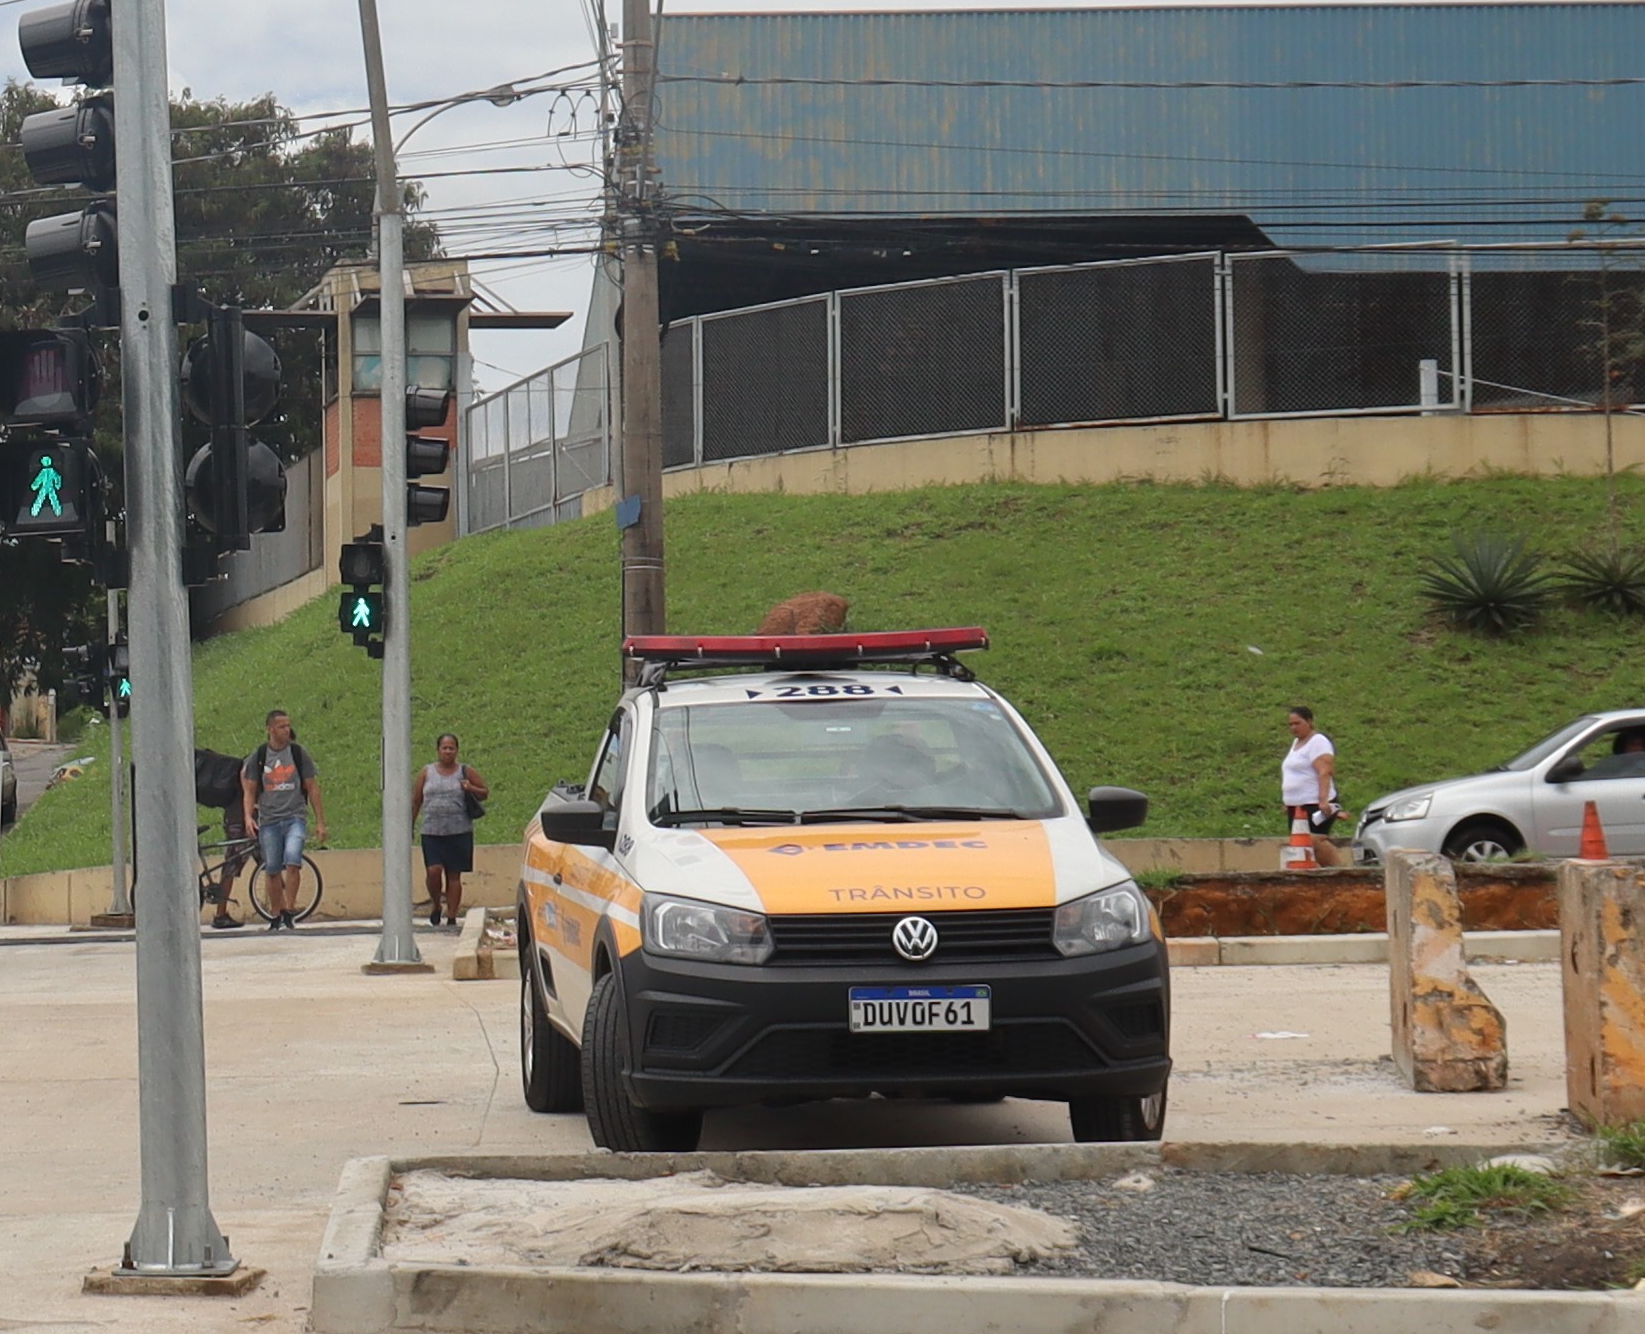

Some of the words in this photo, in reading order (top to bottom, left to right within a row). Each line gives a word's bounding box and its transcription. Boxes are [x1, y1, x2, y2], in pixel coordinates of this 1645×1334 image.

[774, 685, 874, 697] 288
[823, 840, 988, 852] EMDEC
[829, 884, 987, 902] TRÂNSITO
